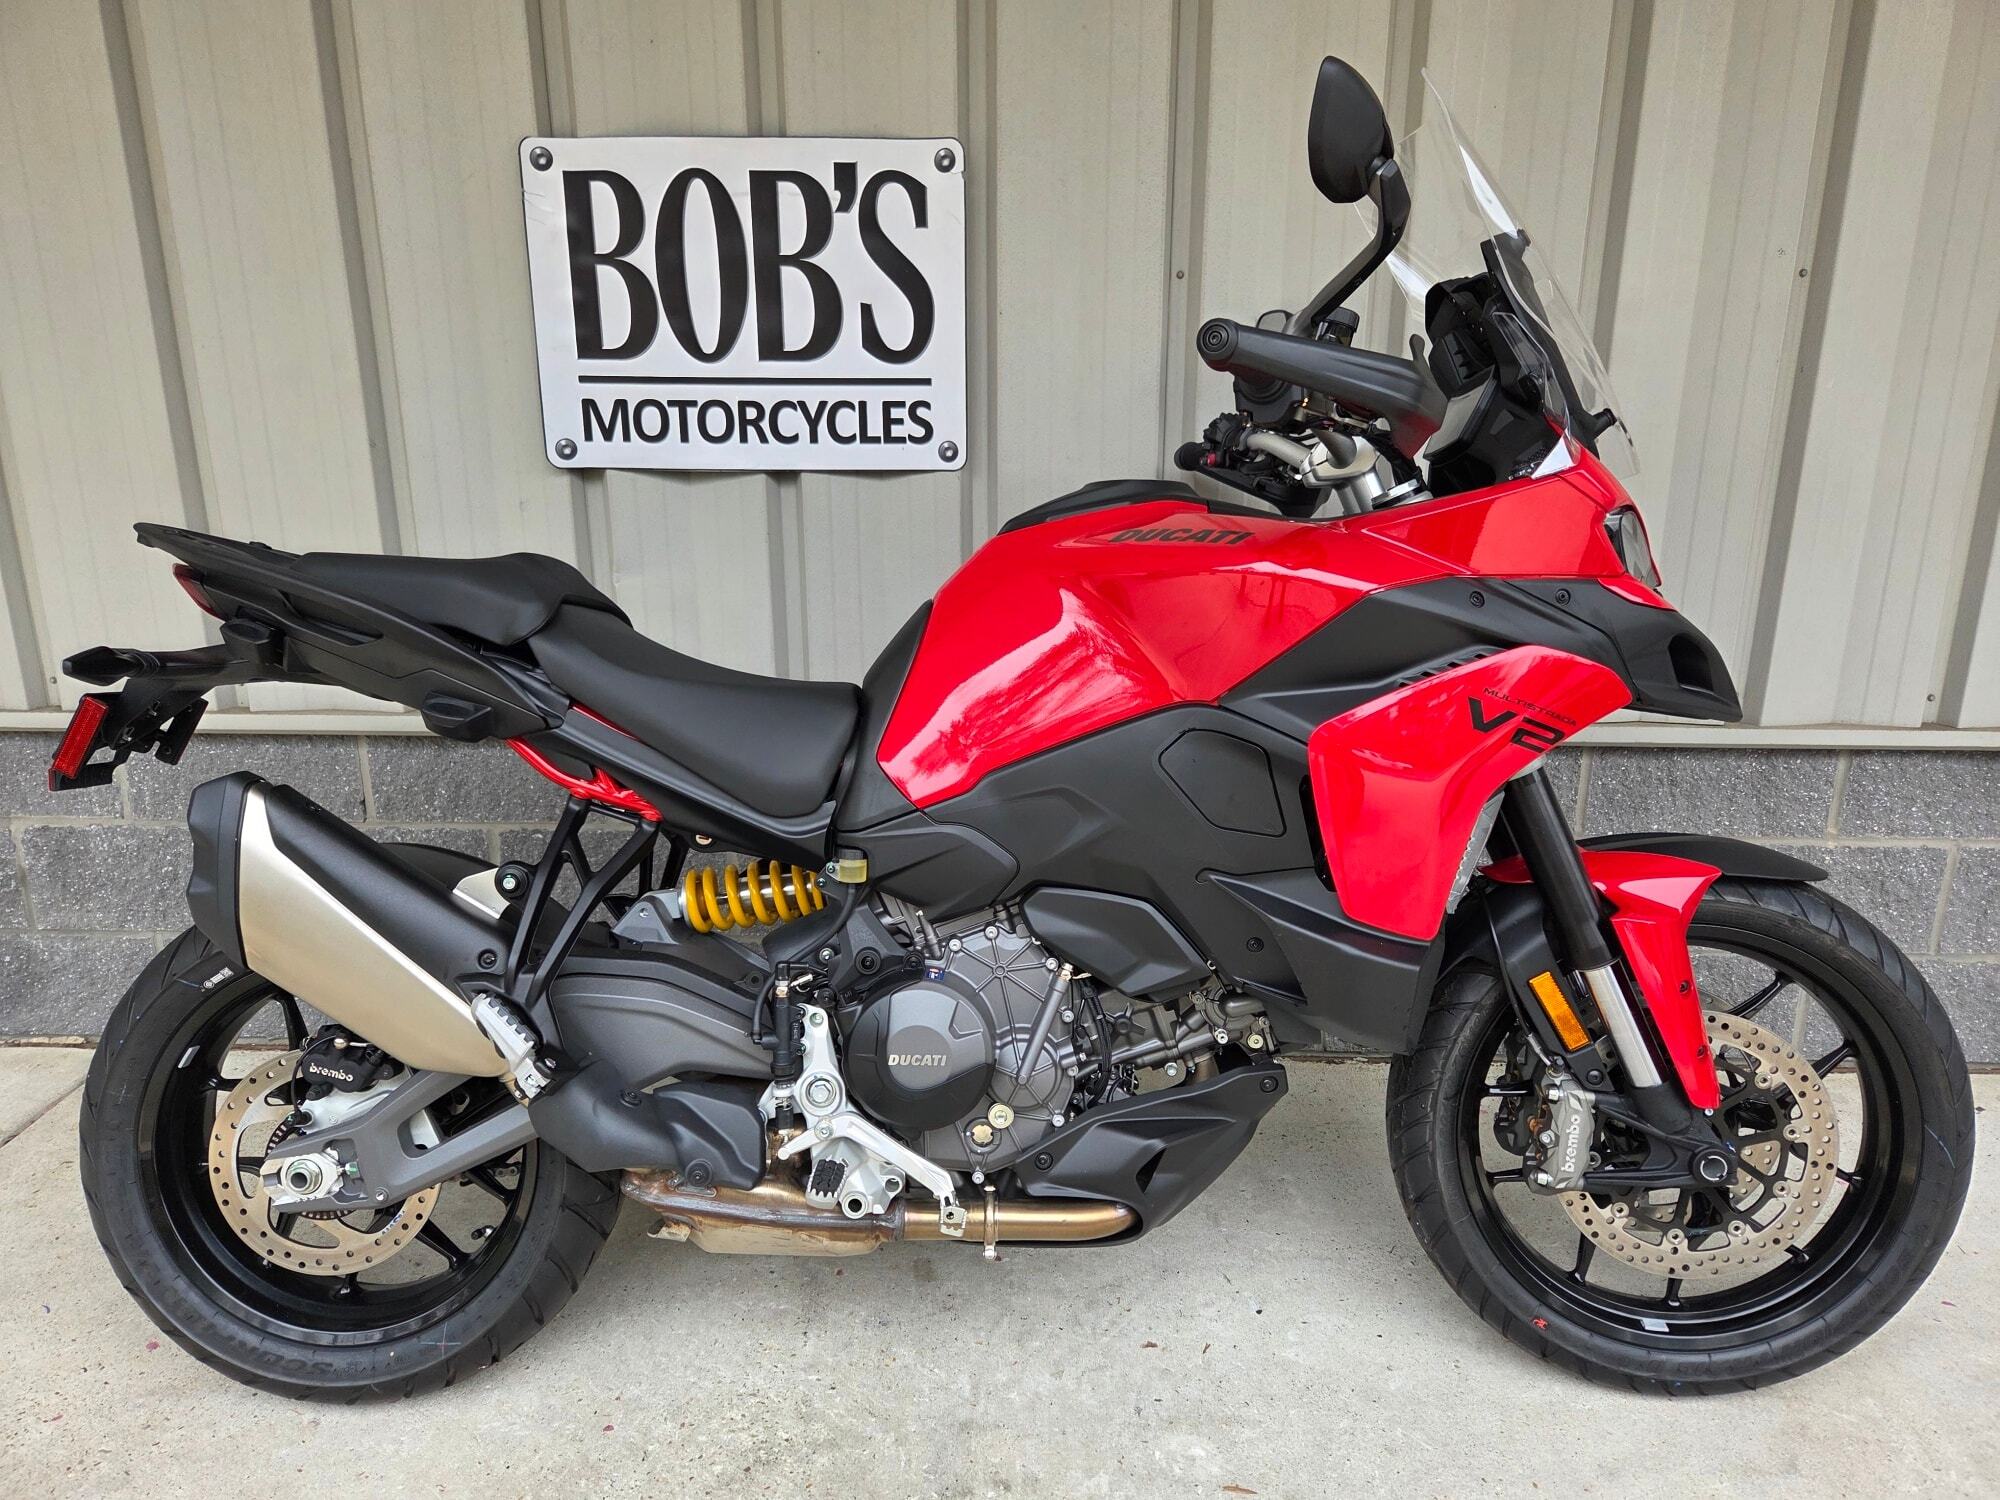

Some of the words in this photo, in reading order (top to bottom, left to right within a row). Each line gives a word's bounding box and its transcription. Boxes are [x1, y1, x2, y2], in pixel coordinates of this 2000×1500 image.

[562, 161, 935, 364] BOB'S
[581, 398, 934, 444] MOTORCYCLES
[1108, 528, 1255, 545] DUCATI
[1467, 695, 1566, 754] V2
[309, 1062, 354, 1082] brembo
[888, 1054, 947, 1066] DUCATI
[1561, 1114, 1580, 1173] brembo
